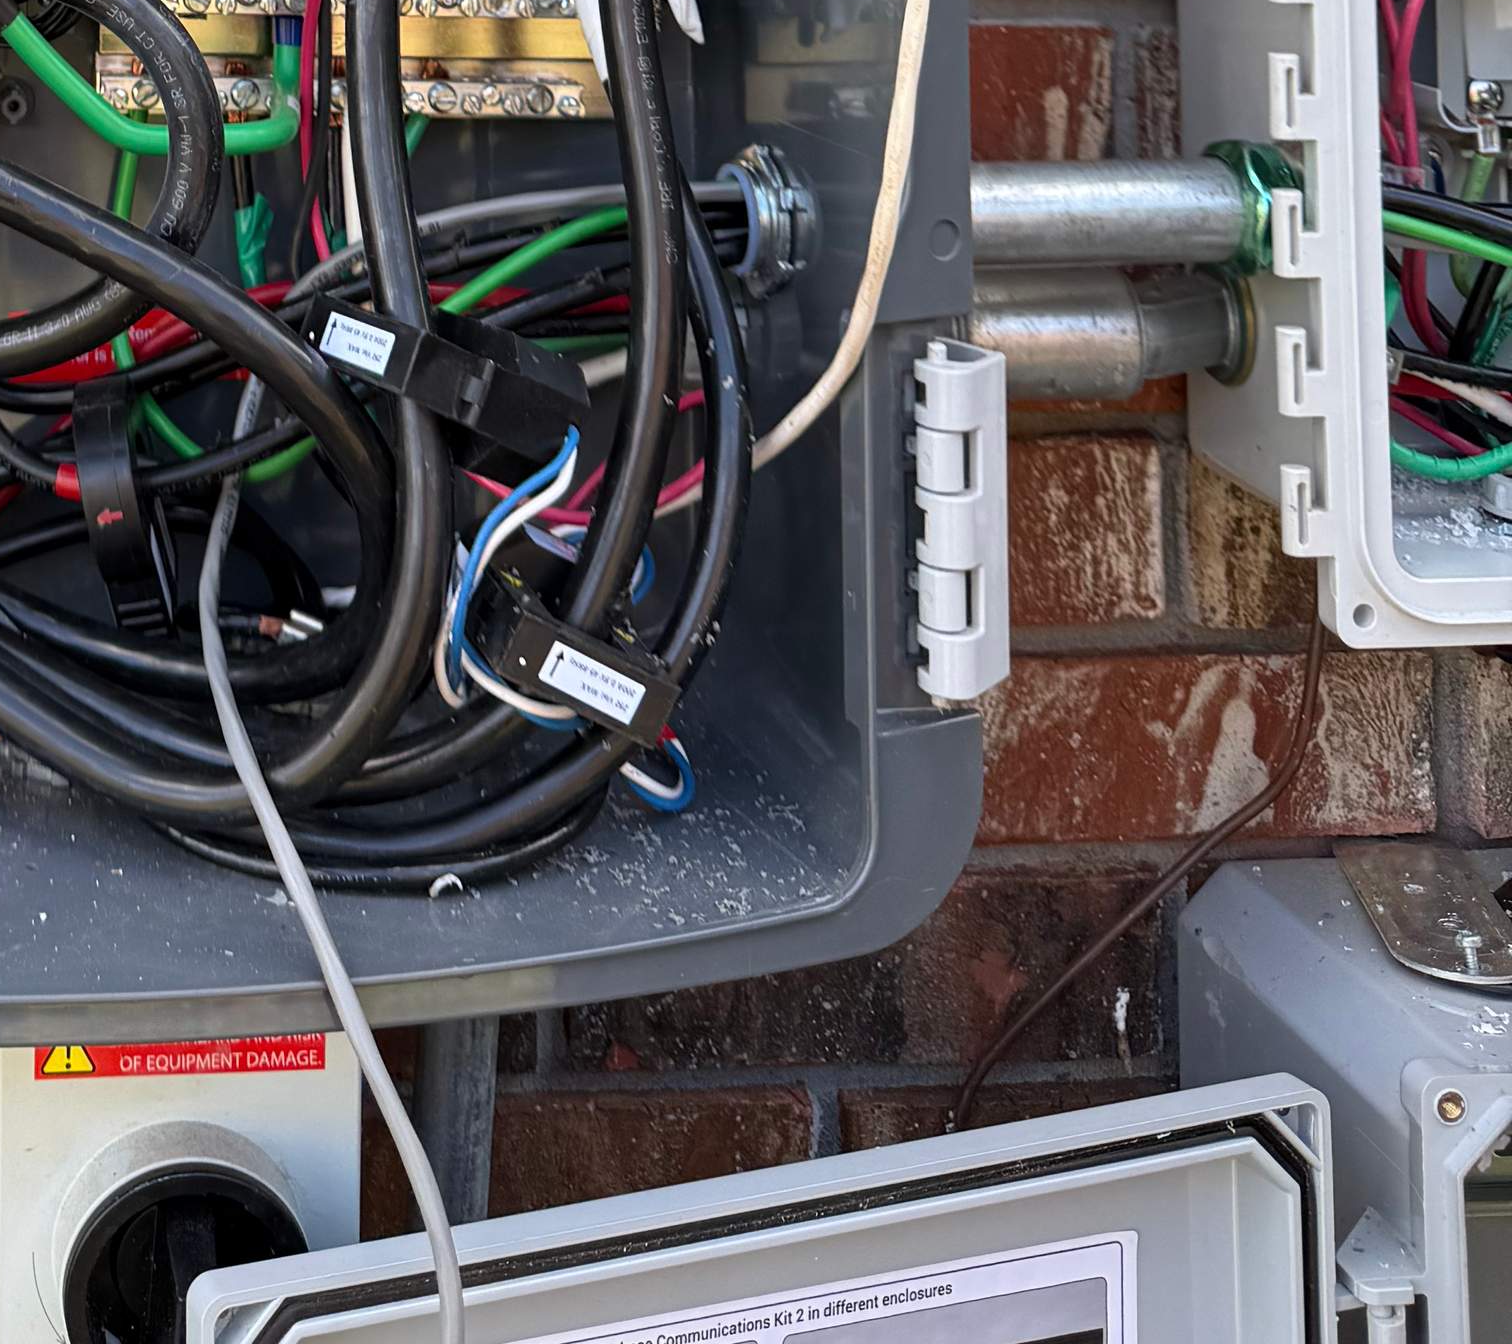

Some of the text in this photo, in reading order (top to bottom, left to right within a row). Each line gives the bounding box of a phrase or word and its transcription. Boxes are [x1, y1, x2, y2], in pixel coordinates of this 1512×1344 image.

[105, 3, 136, 29] USE
[134, 29, 154, 50] CT
[148, 53, 171, 84] FOR
[170, 88, 186, 111] SR
[120, 1049, 322, 1073] OF EQUIPMENT DAMAGE.
[657, 1281, 954, 1344] Communications Kit 2 in different enclosures
